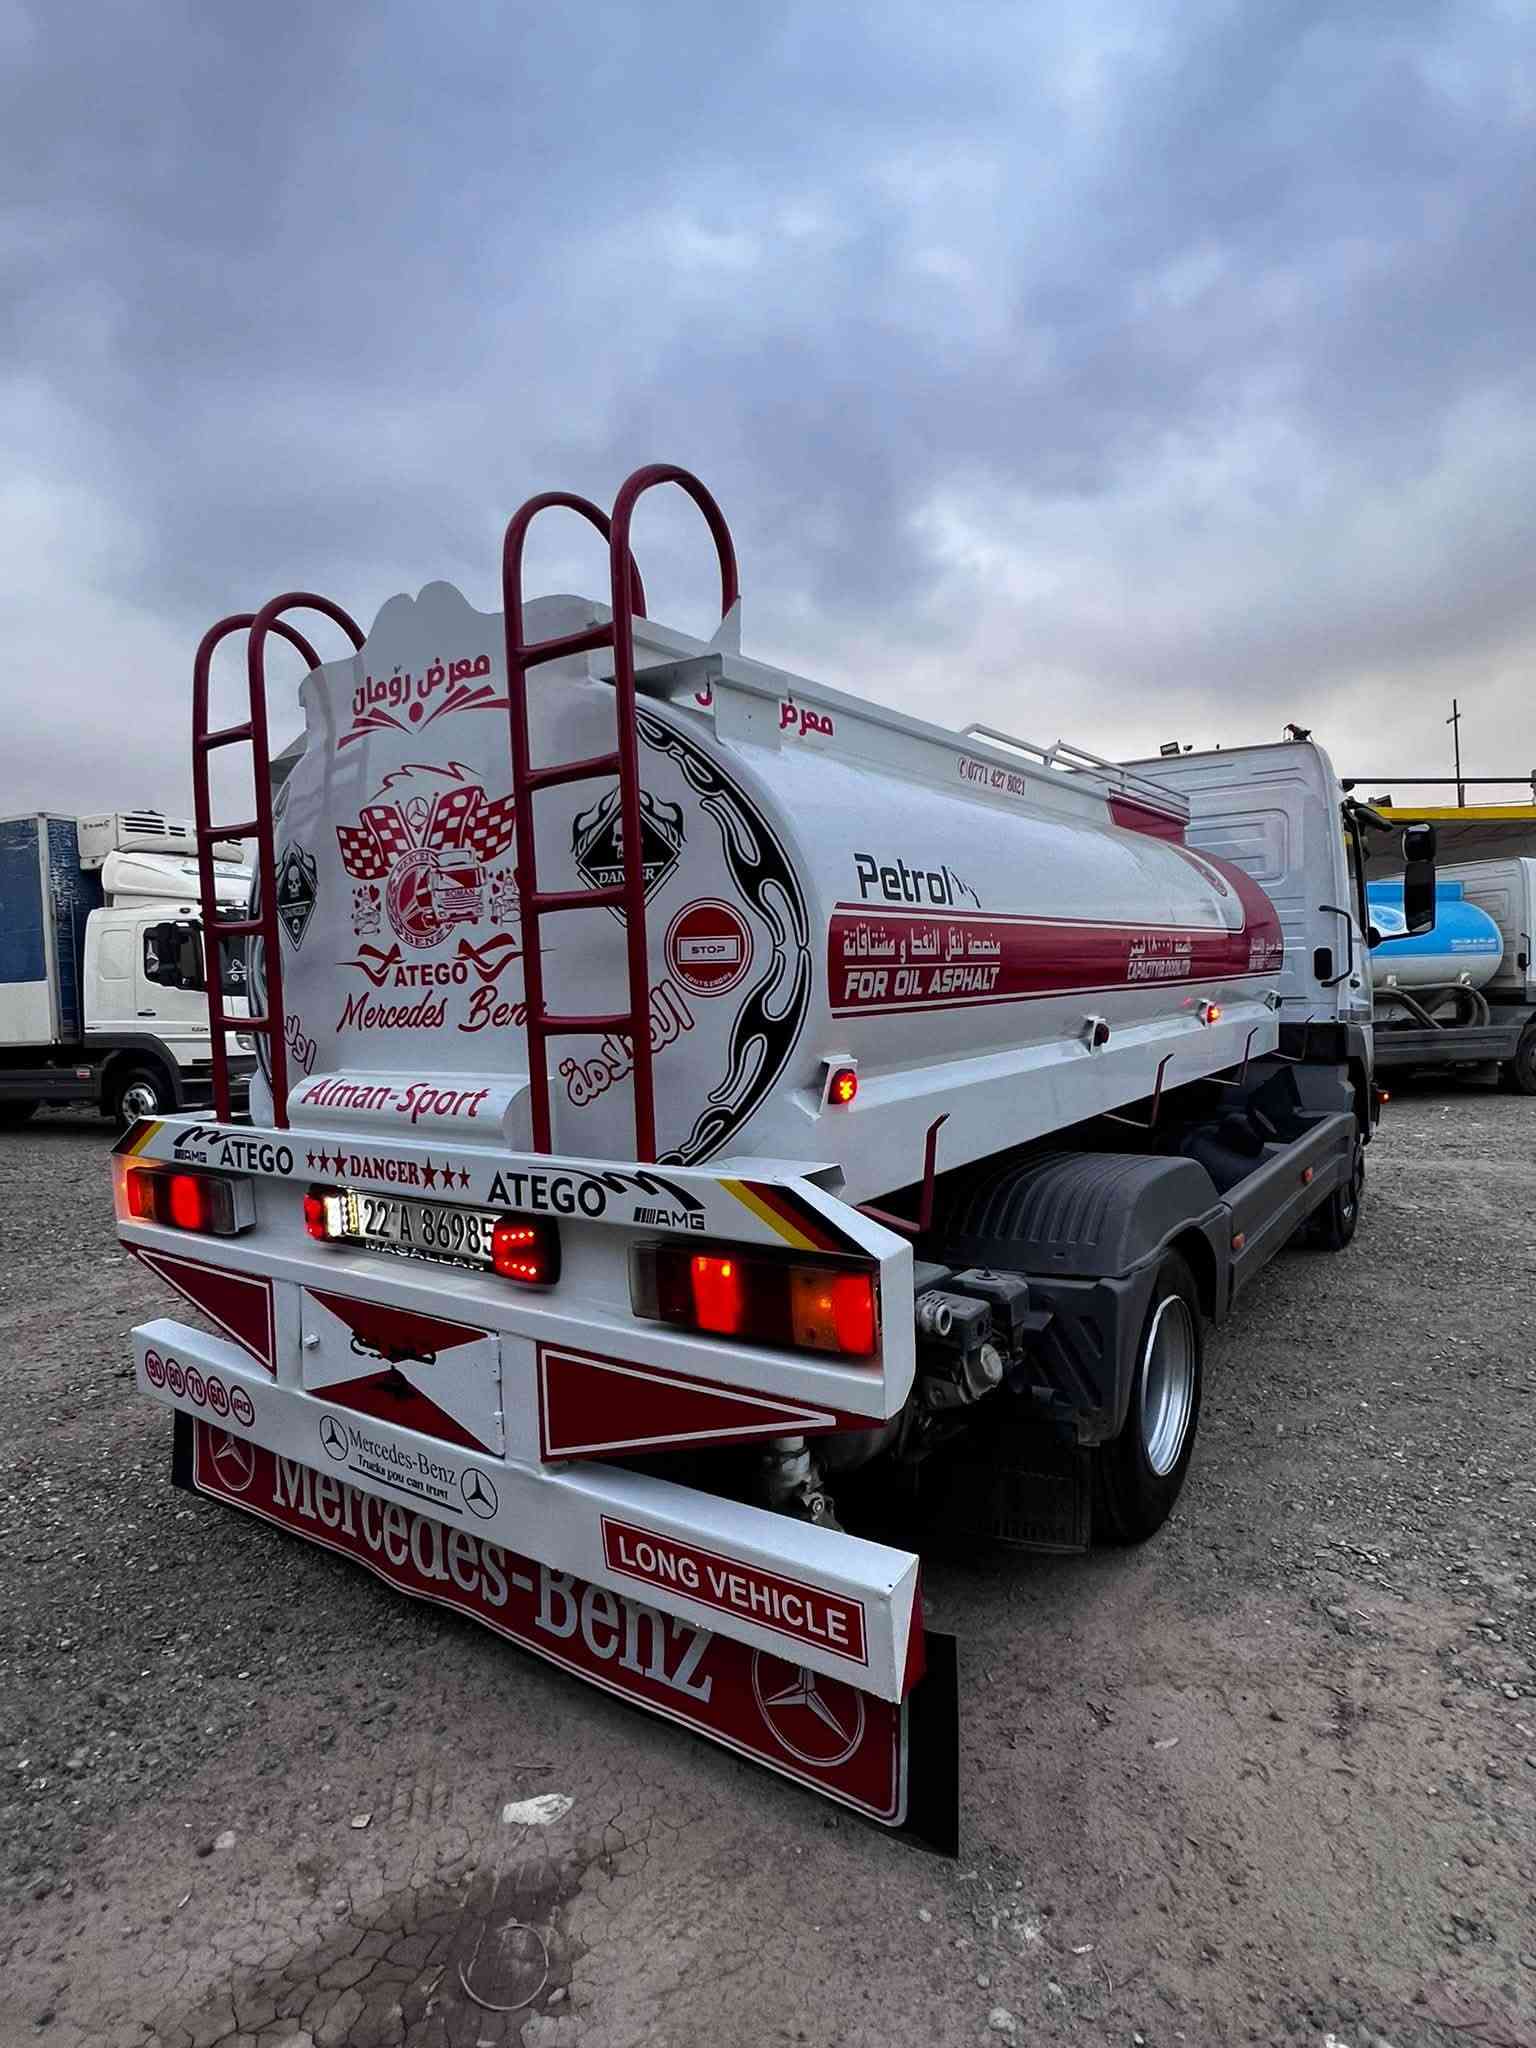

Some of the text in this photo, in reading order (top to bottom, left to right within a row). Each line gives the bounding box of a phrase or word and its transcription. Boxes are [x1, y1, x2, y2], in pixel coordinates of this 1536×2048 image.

[417, 654, 491, 699] معرض
[599, 867, 655, 884] DANER
[854, 852, 954, 906] Petrol
[691, 945, 726, 955] STOP
[899, 938, 906, 965] و
[910, 924, 941, 956] النفط
[394, 961, 468, 988] ATEGO
[844, 966, 1000, 1000] FOR OIL ASPHALT
[336, 984, 548, 1034] Mercedes Ben
[301, 1078, 491, 1124] Alman-Sport
[220, 1140, 293, 1175] ATEGO
[350, 1155, 420, 1185] DANGER
[488, 1170, 607, 1218] ATEGO
[364, 1199, 390, 1238] 22
[399, 1205, 413, 1242] A
[188, 1374, 203, 1399] 70
[347, 1426, 457, 1486] Mercedes-Benz
[406, 1477, 425, 1491] can
[272, 1455, 713, 1704] Mercedes-Benz
[618, 1535, 850, 1645] LONG VEHICLE
